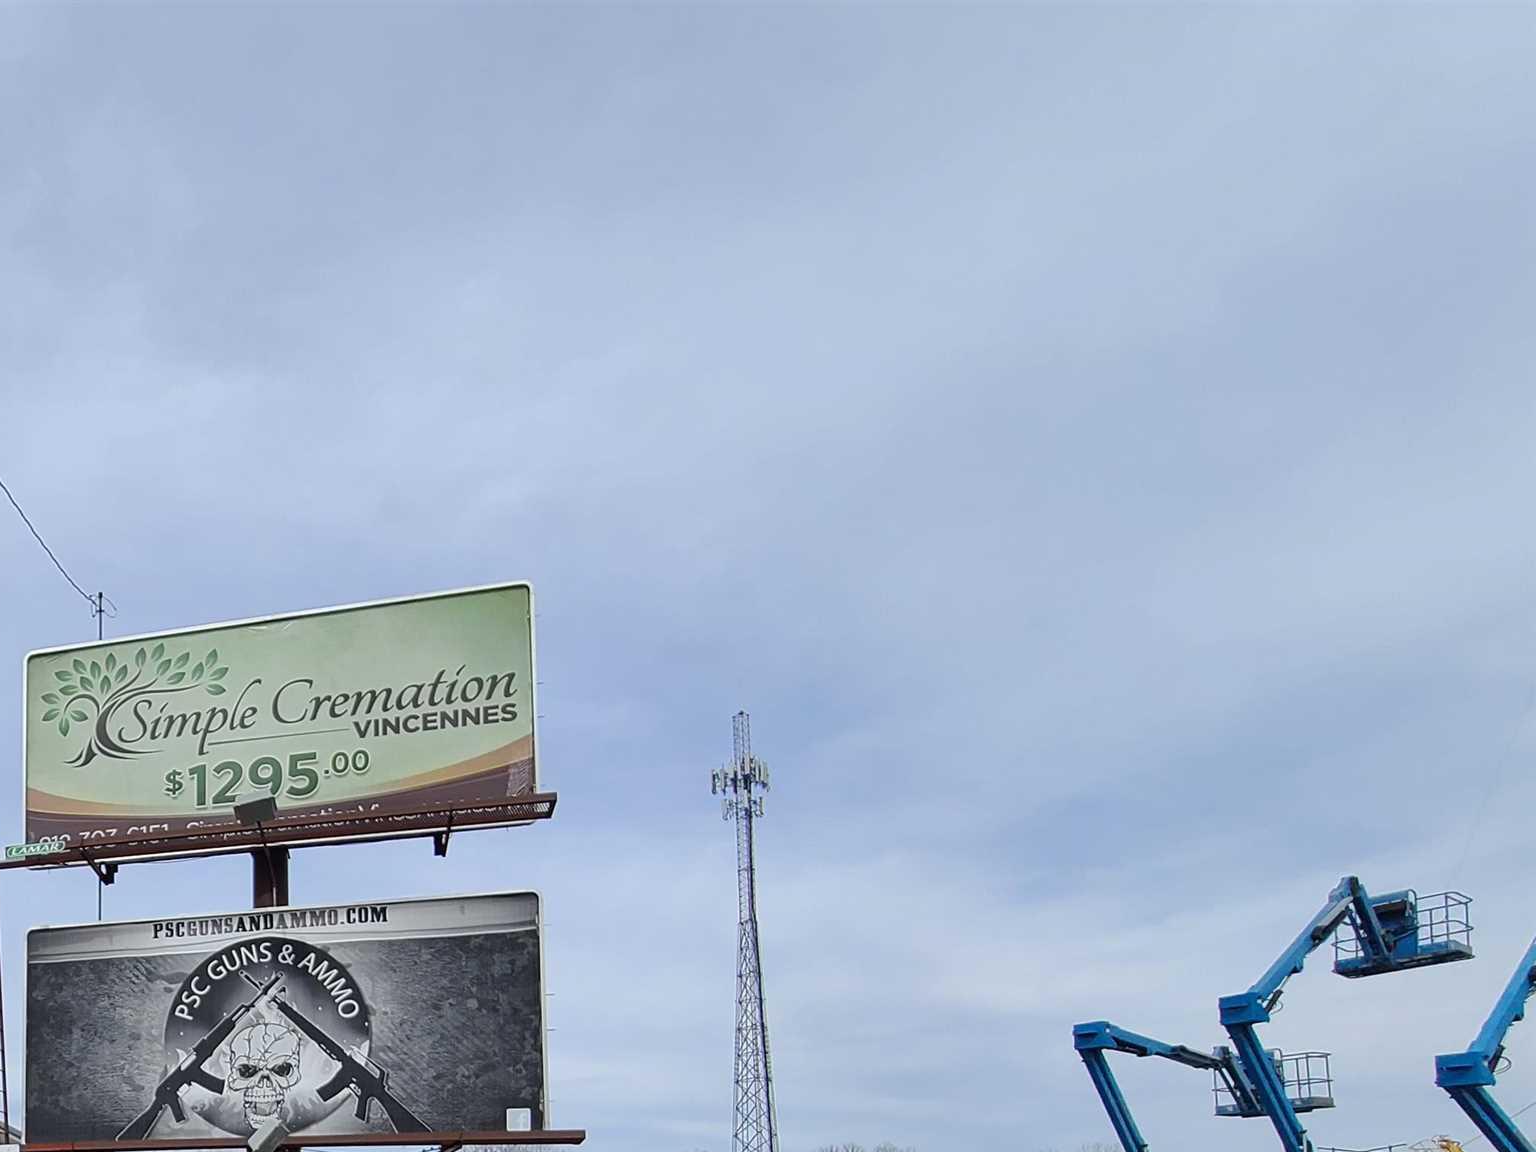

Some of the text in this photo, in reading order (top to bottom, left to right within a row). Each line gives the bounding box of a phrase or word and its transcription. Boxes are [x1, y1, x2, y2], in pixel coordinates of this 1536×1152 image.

[118, 664, 518, 756] Simple Cremation
[353, 703, 518, 738] VINCENNES
[11, 842, 60, 856] LAMAR
[152, 906, 389, 939] PSCGUNSANDAMMO.COM
[174, 942, 360, 1021] PSC GUNS & AMMO
